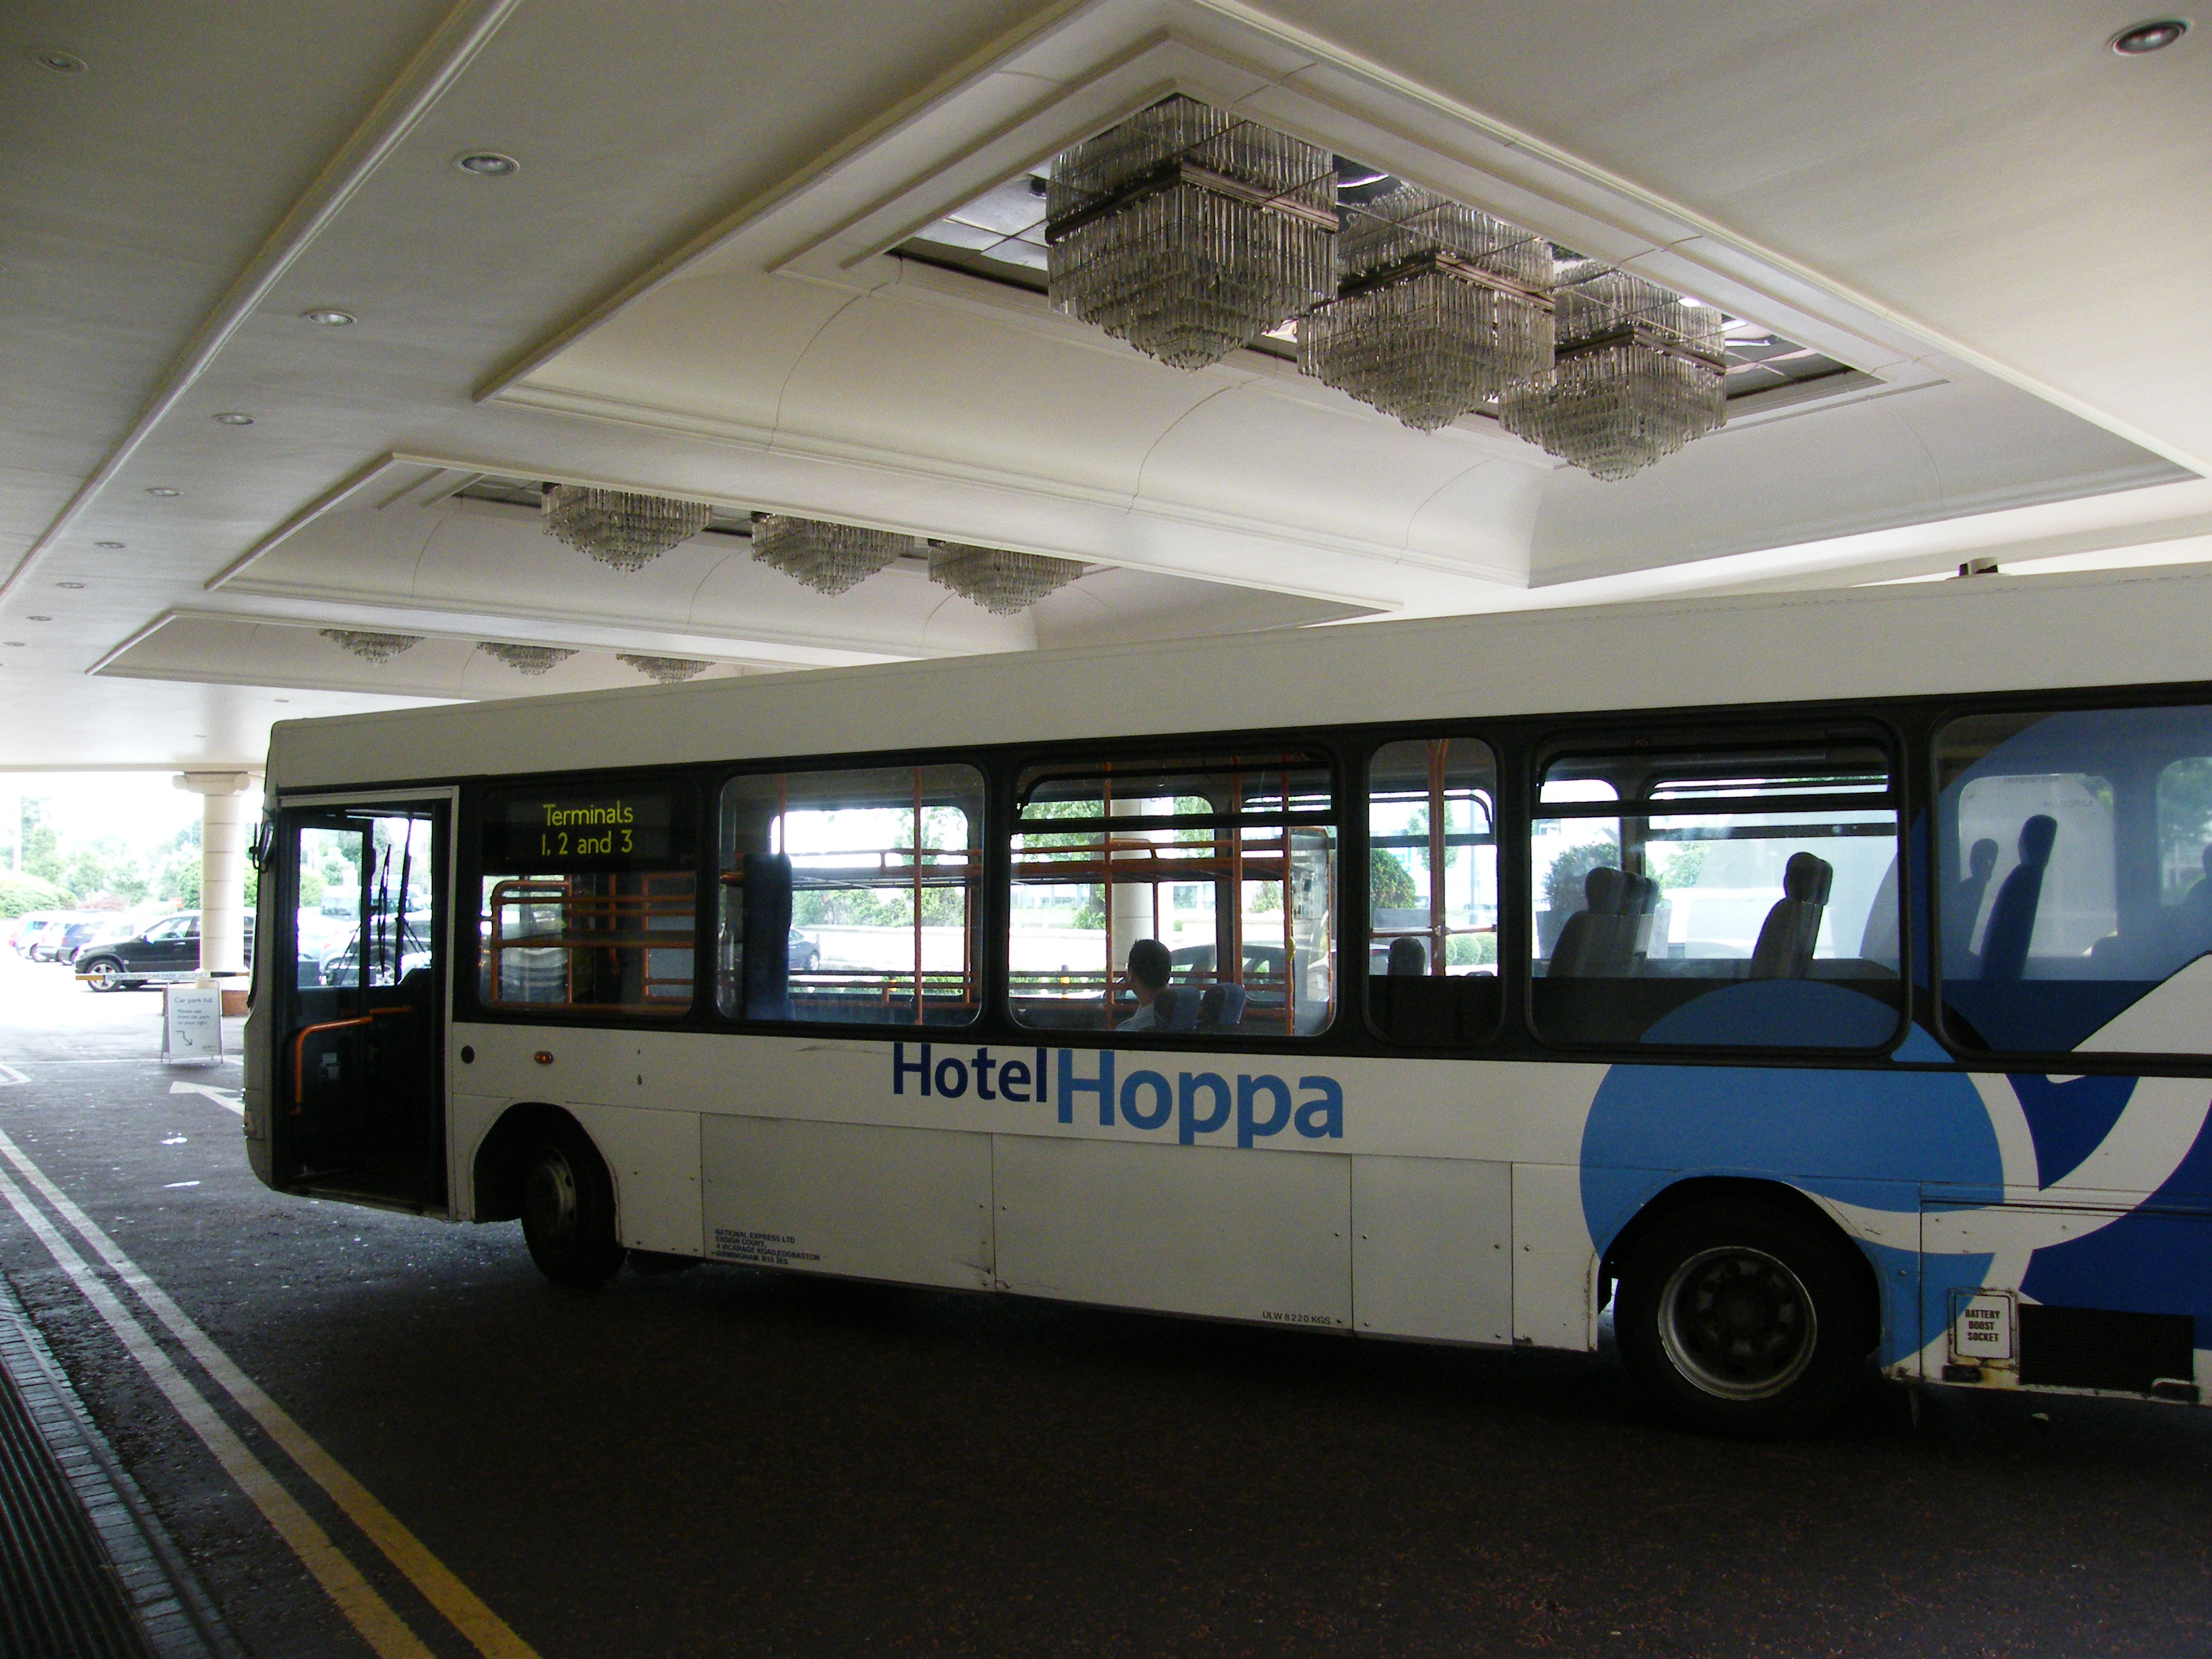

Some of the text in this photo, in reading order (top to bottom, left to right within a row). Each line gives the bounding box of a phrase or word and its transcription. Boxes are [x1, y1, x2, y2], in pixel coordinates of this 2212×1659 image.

[543, 800, 634, 826] Terminals
[558, 832, 569, 855] 2
[577, 831, 612, 854] and
[621, 830, 633, 853] 3
[893, 1042, 1344, 1149] Hotel Hoppa
[715, 1228, 796, 1244] NATIONAL EXPRESS LTD
[716, 1235, 740, 1244] ENSIGN
[722, 1244, 756, 1254] VICARAGE
[1263, 1311, 1331, 1324] ULW 8220 KGS
[1965, 1309, 2001, 1319] BATTERY
[1969, 1321, 1994, 1330] BOOST
[1967, 1332, 1999, 1342] SOCKET
